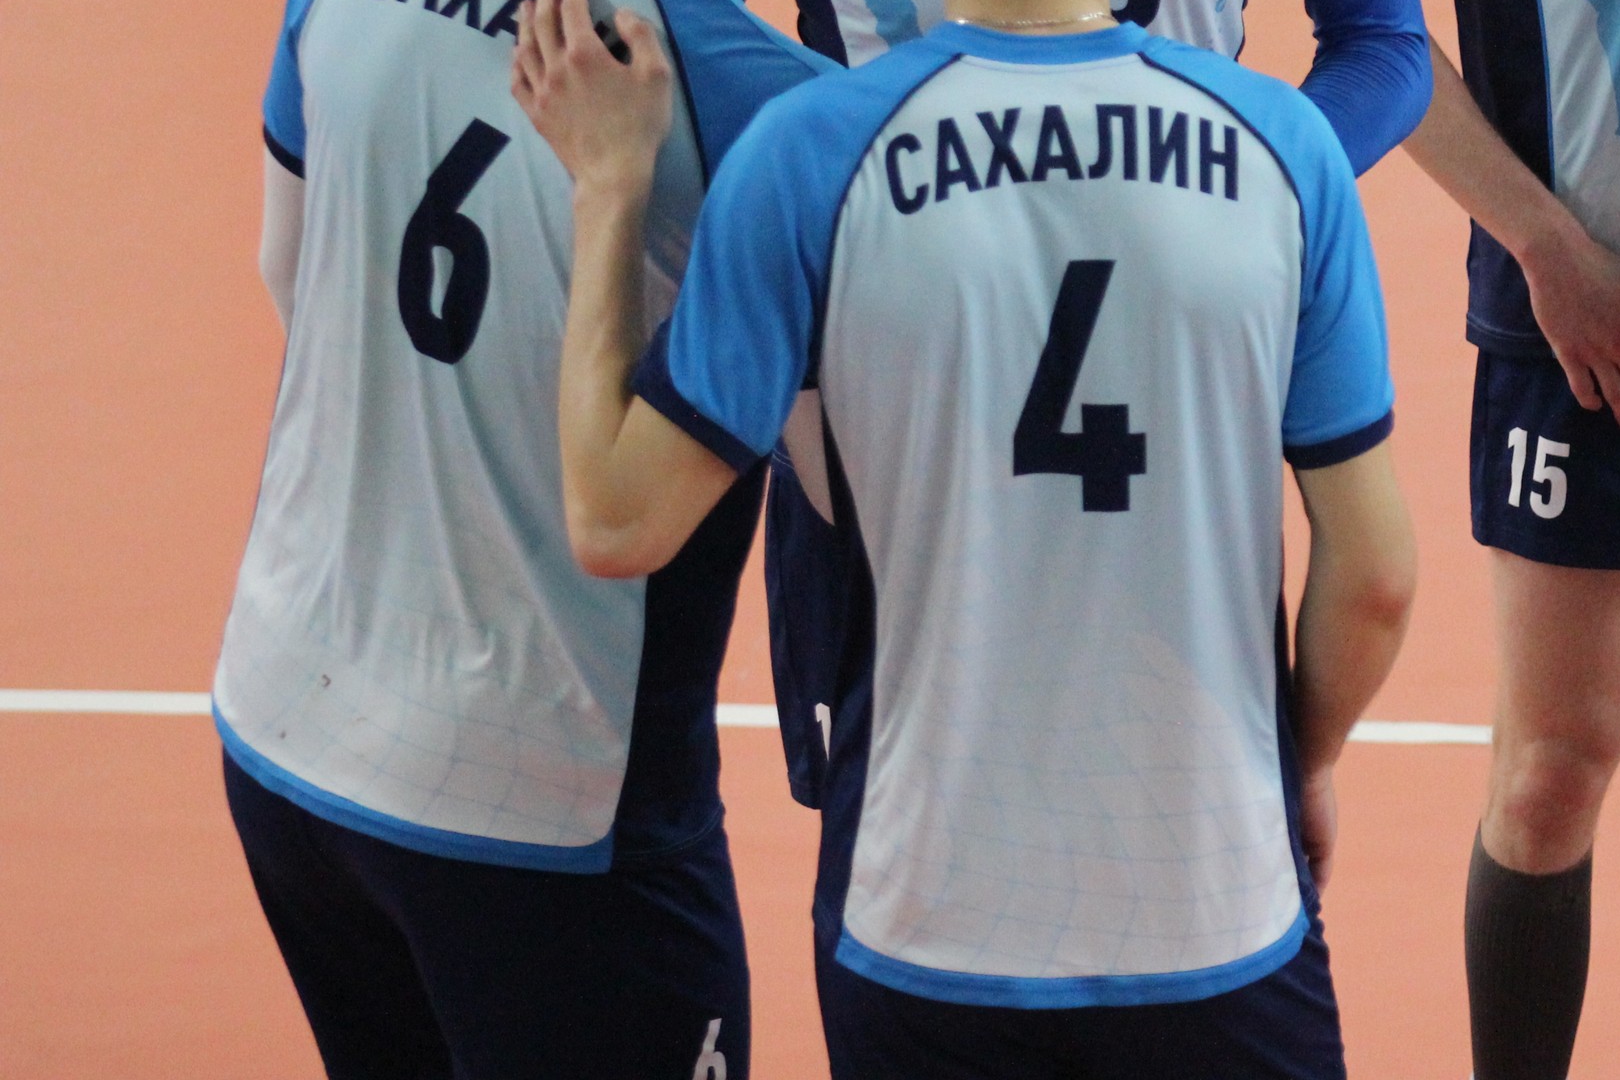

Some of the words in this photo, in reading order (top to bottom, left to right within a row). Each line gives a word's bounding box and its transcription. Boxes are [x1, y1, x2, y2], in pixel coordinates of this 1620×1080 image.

[884, 103, 1239, 215] САХАЛИН
[398, 118, 511, 365] 6
[1013, 259, 1146, 512] 4
[1507, 426, 1571, 519] 15
[692, 1018, 727, 1080] 6
